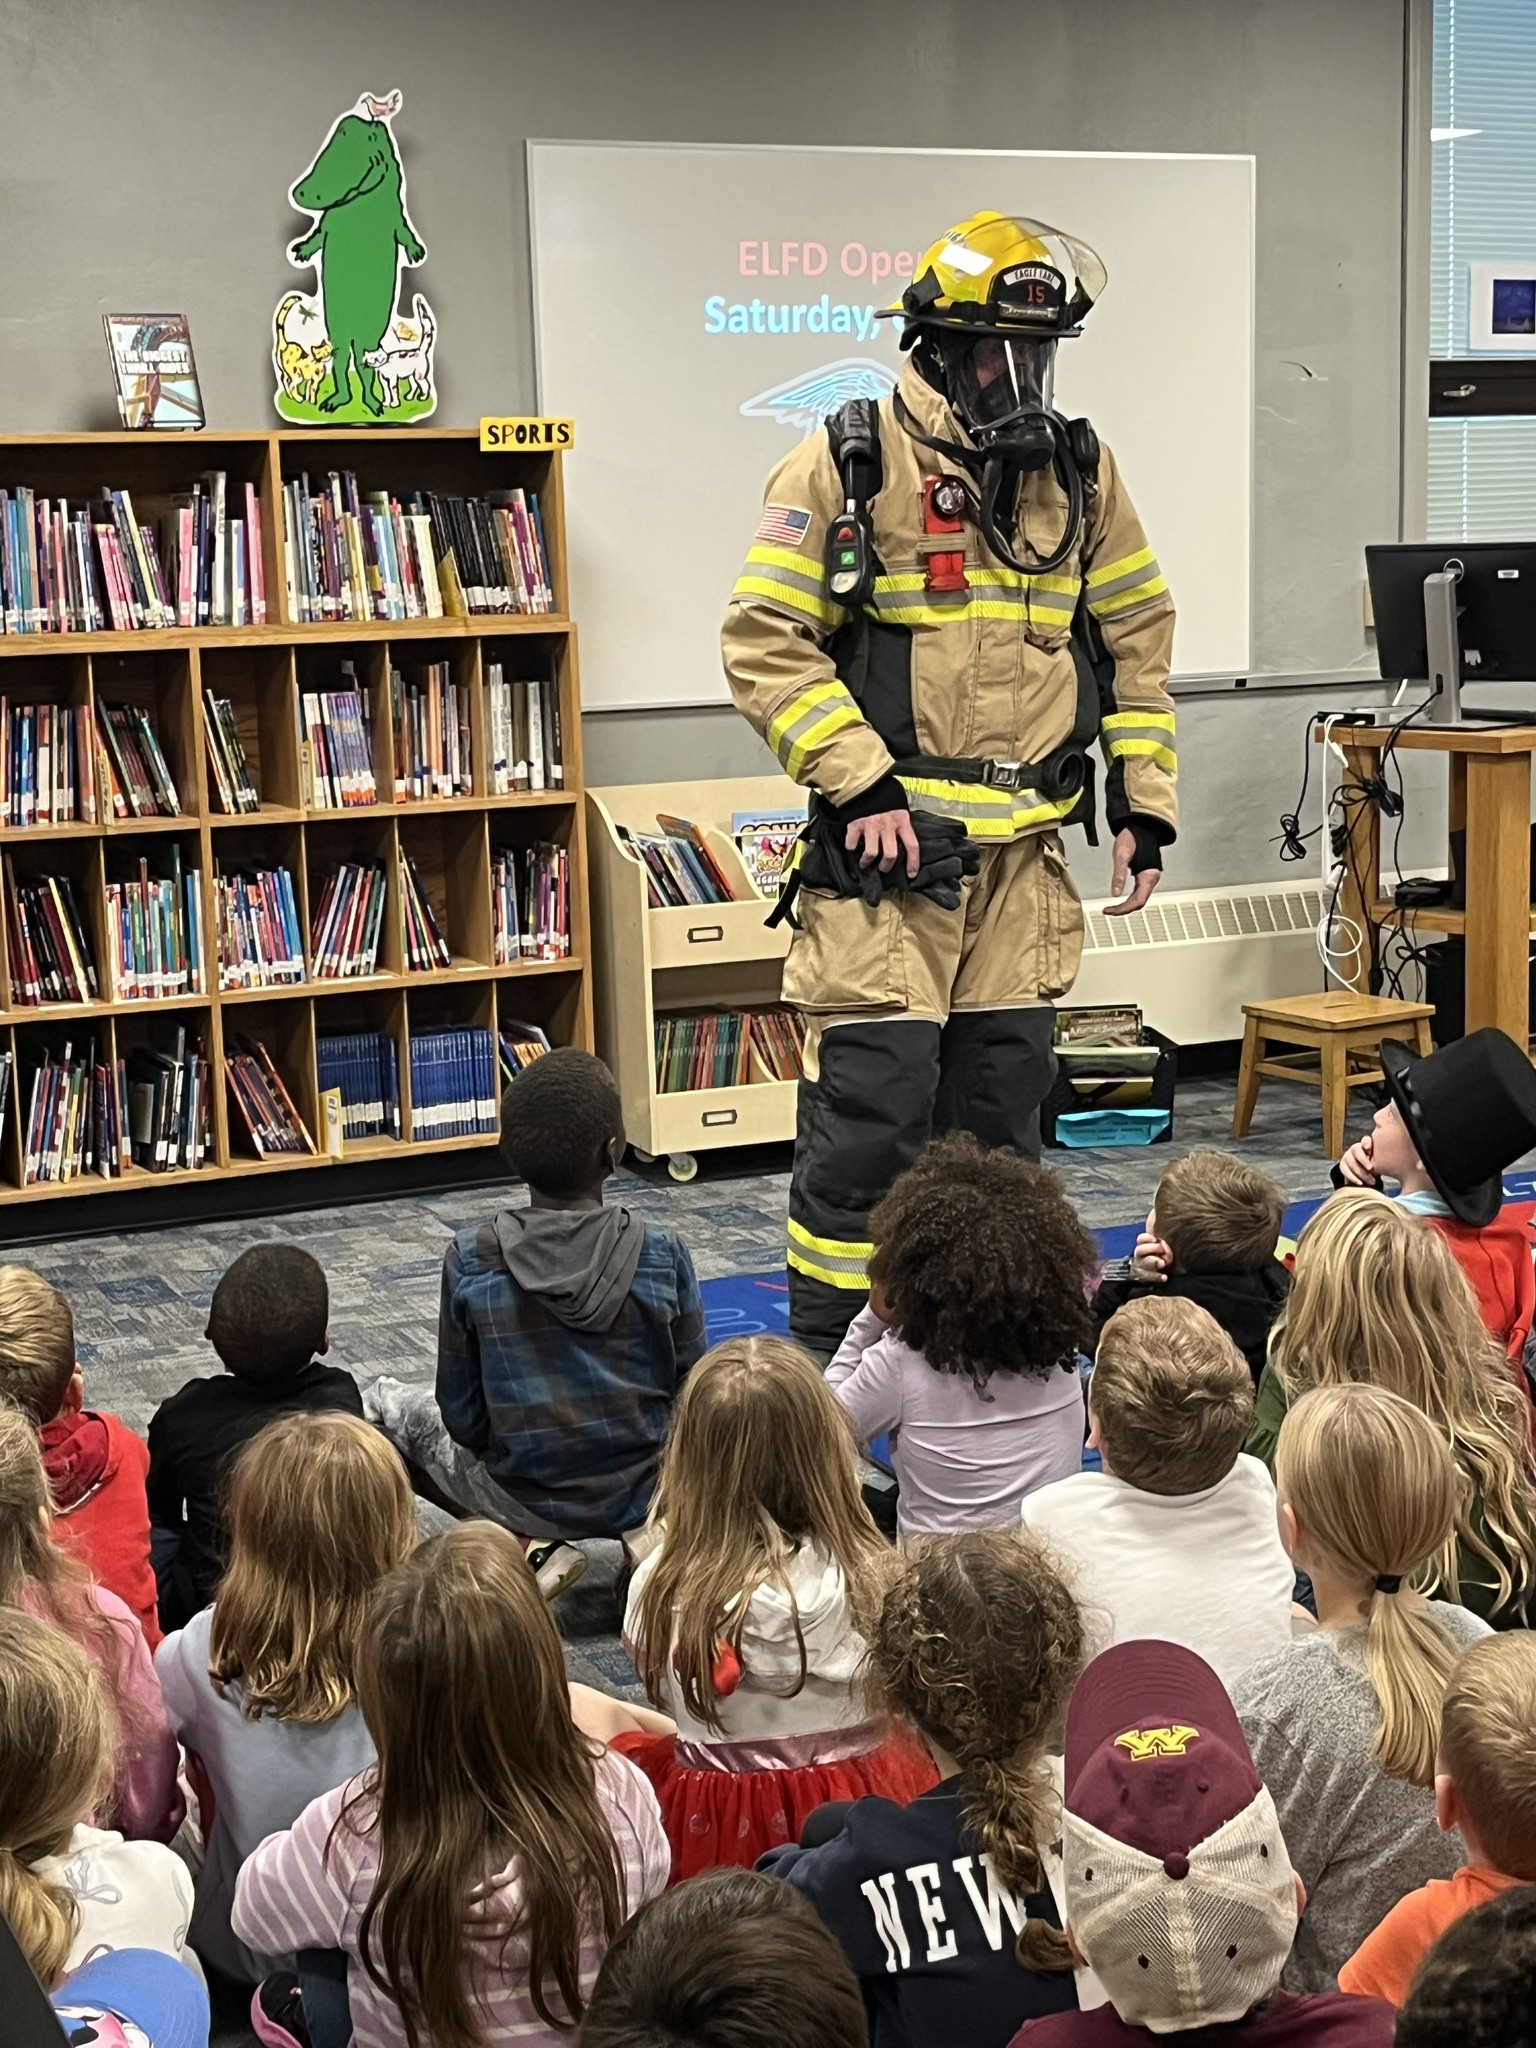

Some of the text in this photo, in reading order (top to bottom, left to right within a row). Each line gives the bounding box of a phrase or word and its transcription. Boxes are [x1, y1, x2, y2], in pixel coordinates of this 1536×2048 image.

[738, 240, 829, 277] ELFD
[1027, 284, 1045, 304] 15
[703, 293, 882, 342] Saturday,
[487, 423, 570, 445] SPORTS
